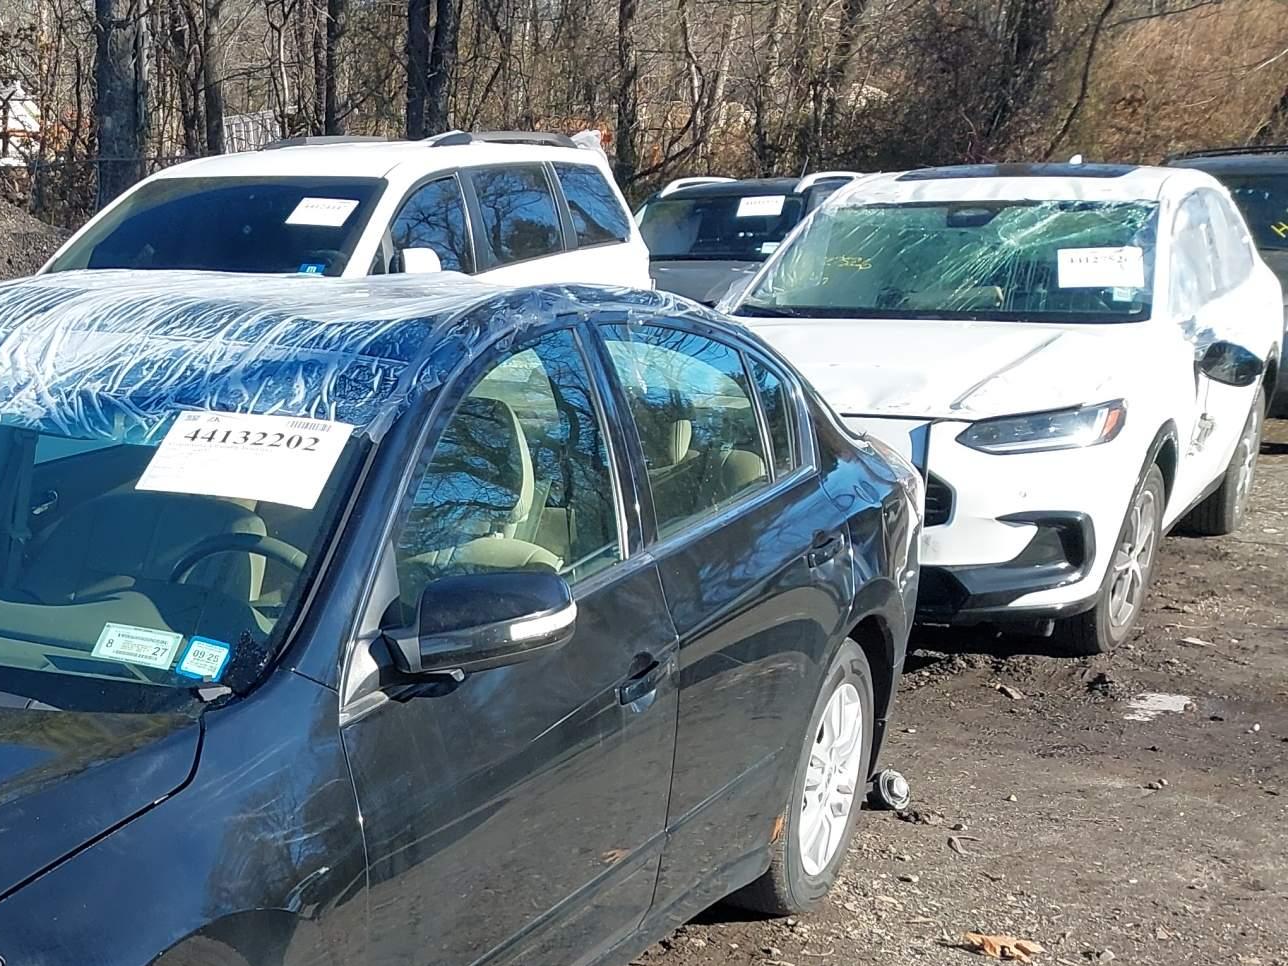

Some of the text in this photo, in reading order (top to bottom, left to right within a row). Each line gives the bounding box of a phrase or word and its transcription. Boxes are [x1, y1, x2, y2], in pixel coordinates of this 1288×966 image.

[184, 427, 321, 452] 44132202
[152, 646, 169, 658] 27
[192, 649, 206, 660] 09
